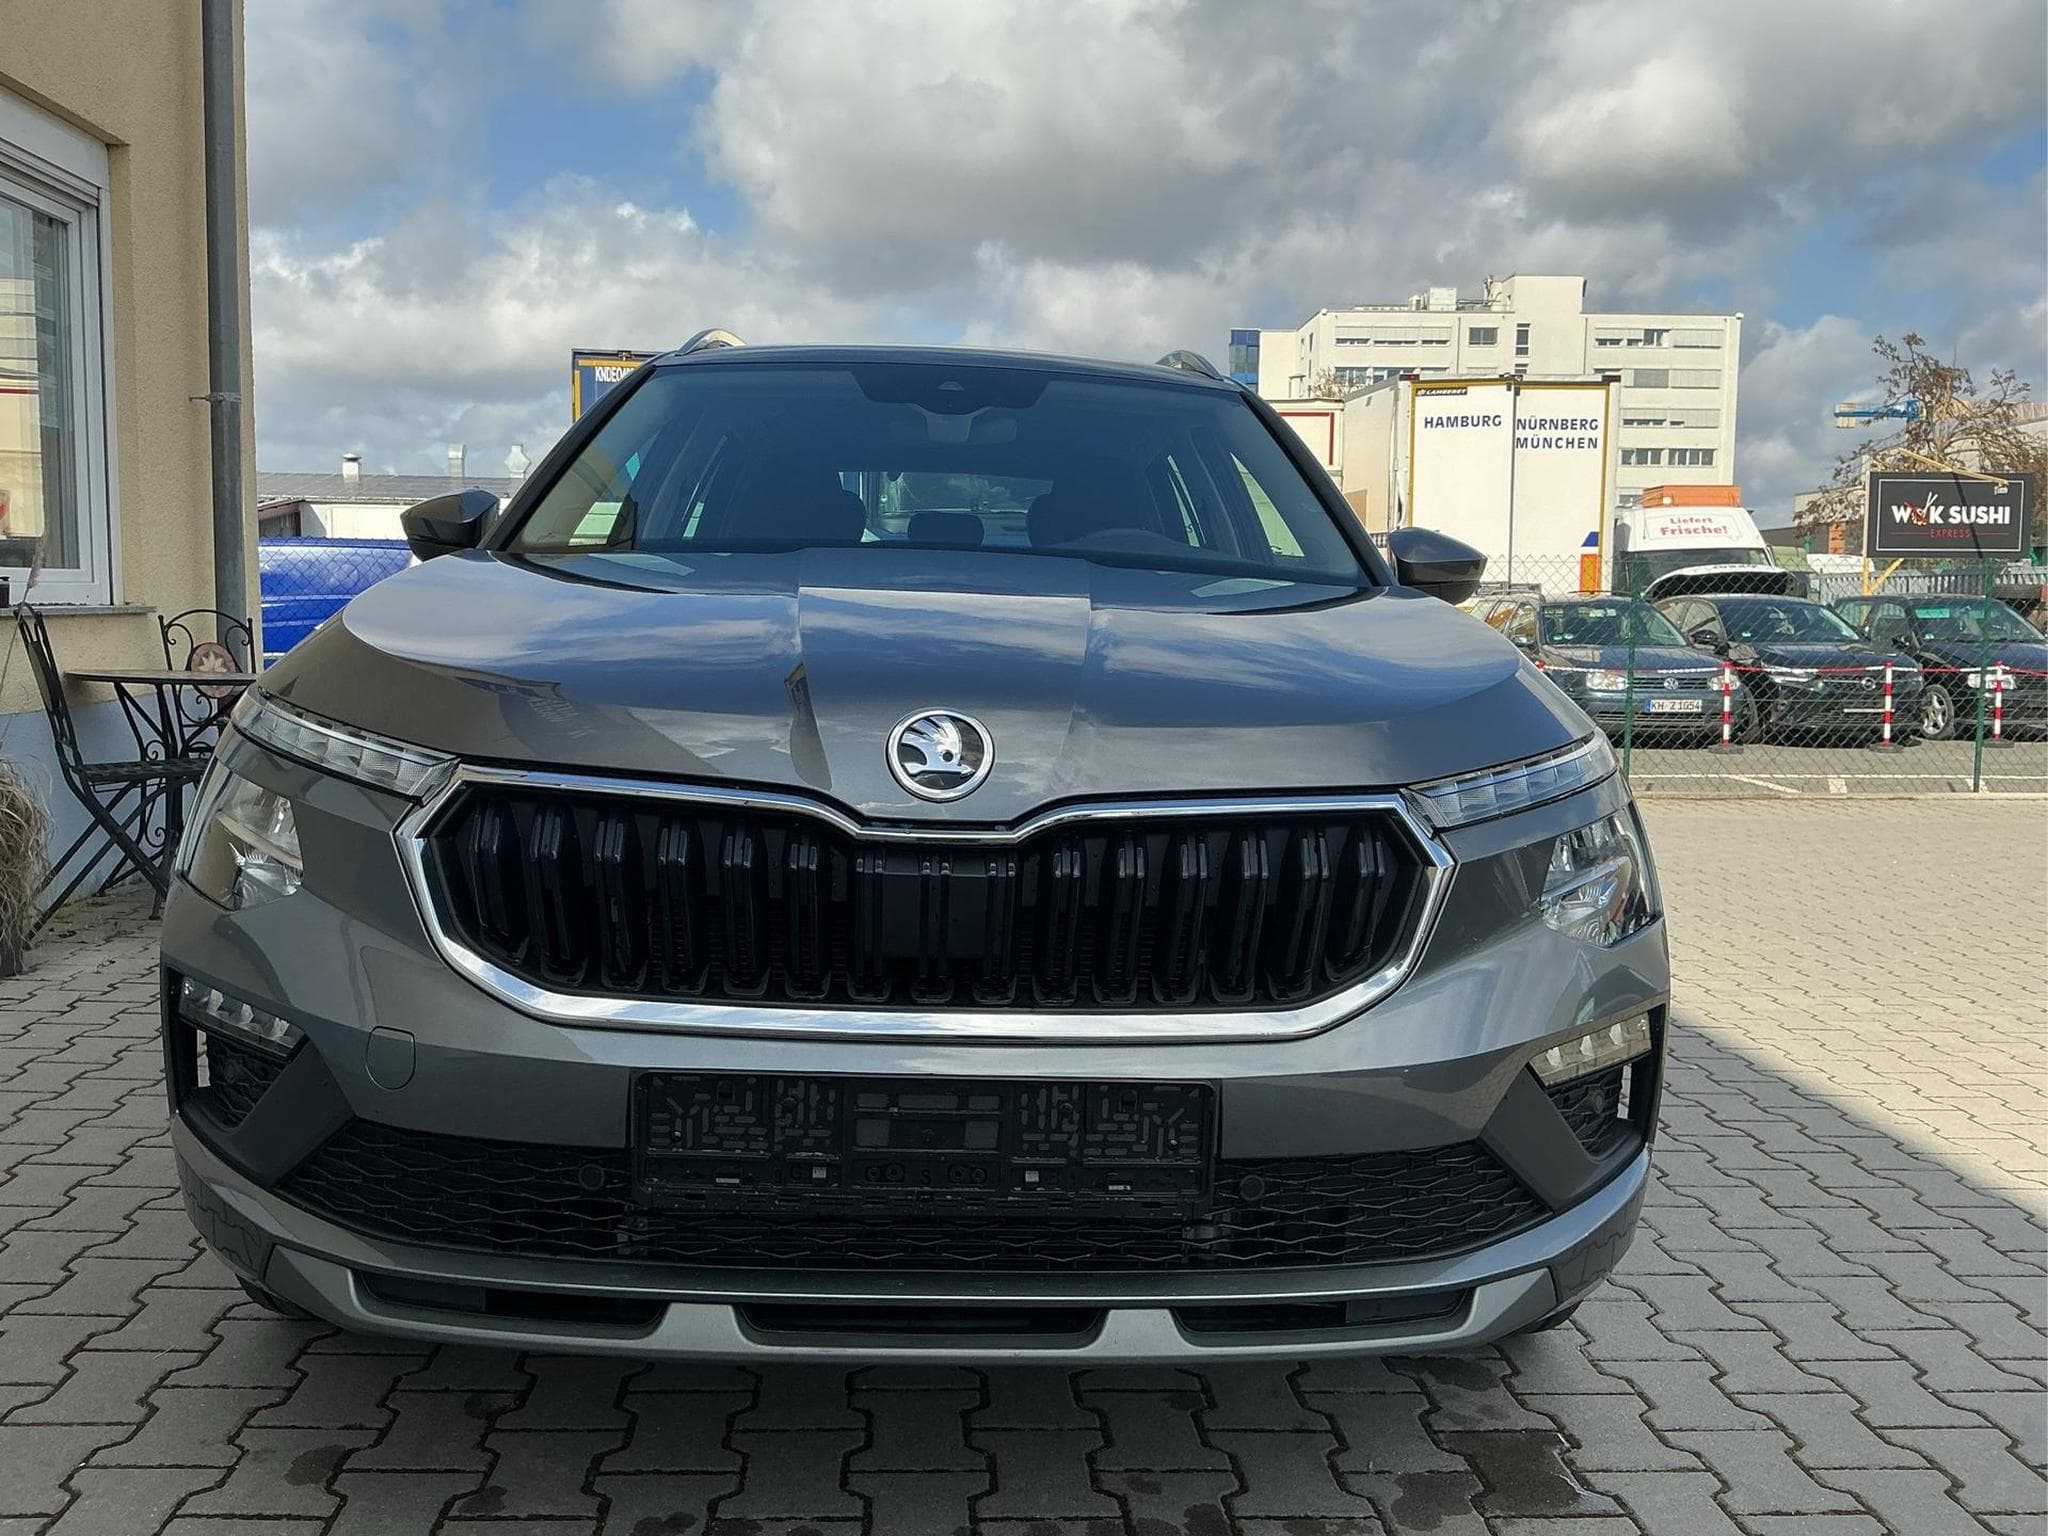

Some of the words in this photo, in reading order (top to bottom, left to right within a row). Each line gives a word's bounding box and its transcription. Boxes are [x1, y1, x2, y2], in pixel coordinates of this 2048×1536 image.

[1424, 415, 1502, 429] HAMBURG
[1516, 415, 1599, 431] NÜRNBERG
[1515, 434, 1599, 449] MÜNCHEN
[1670, 517, 1713, 525] Liefert
[1948, 505, 2011, 525] SUSHI
[1660, 525, 1728, 536] Frische!
[1930, 528, 1970, 538] EXPRESS
